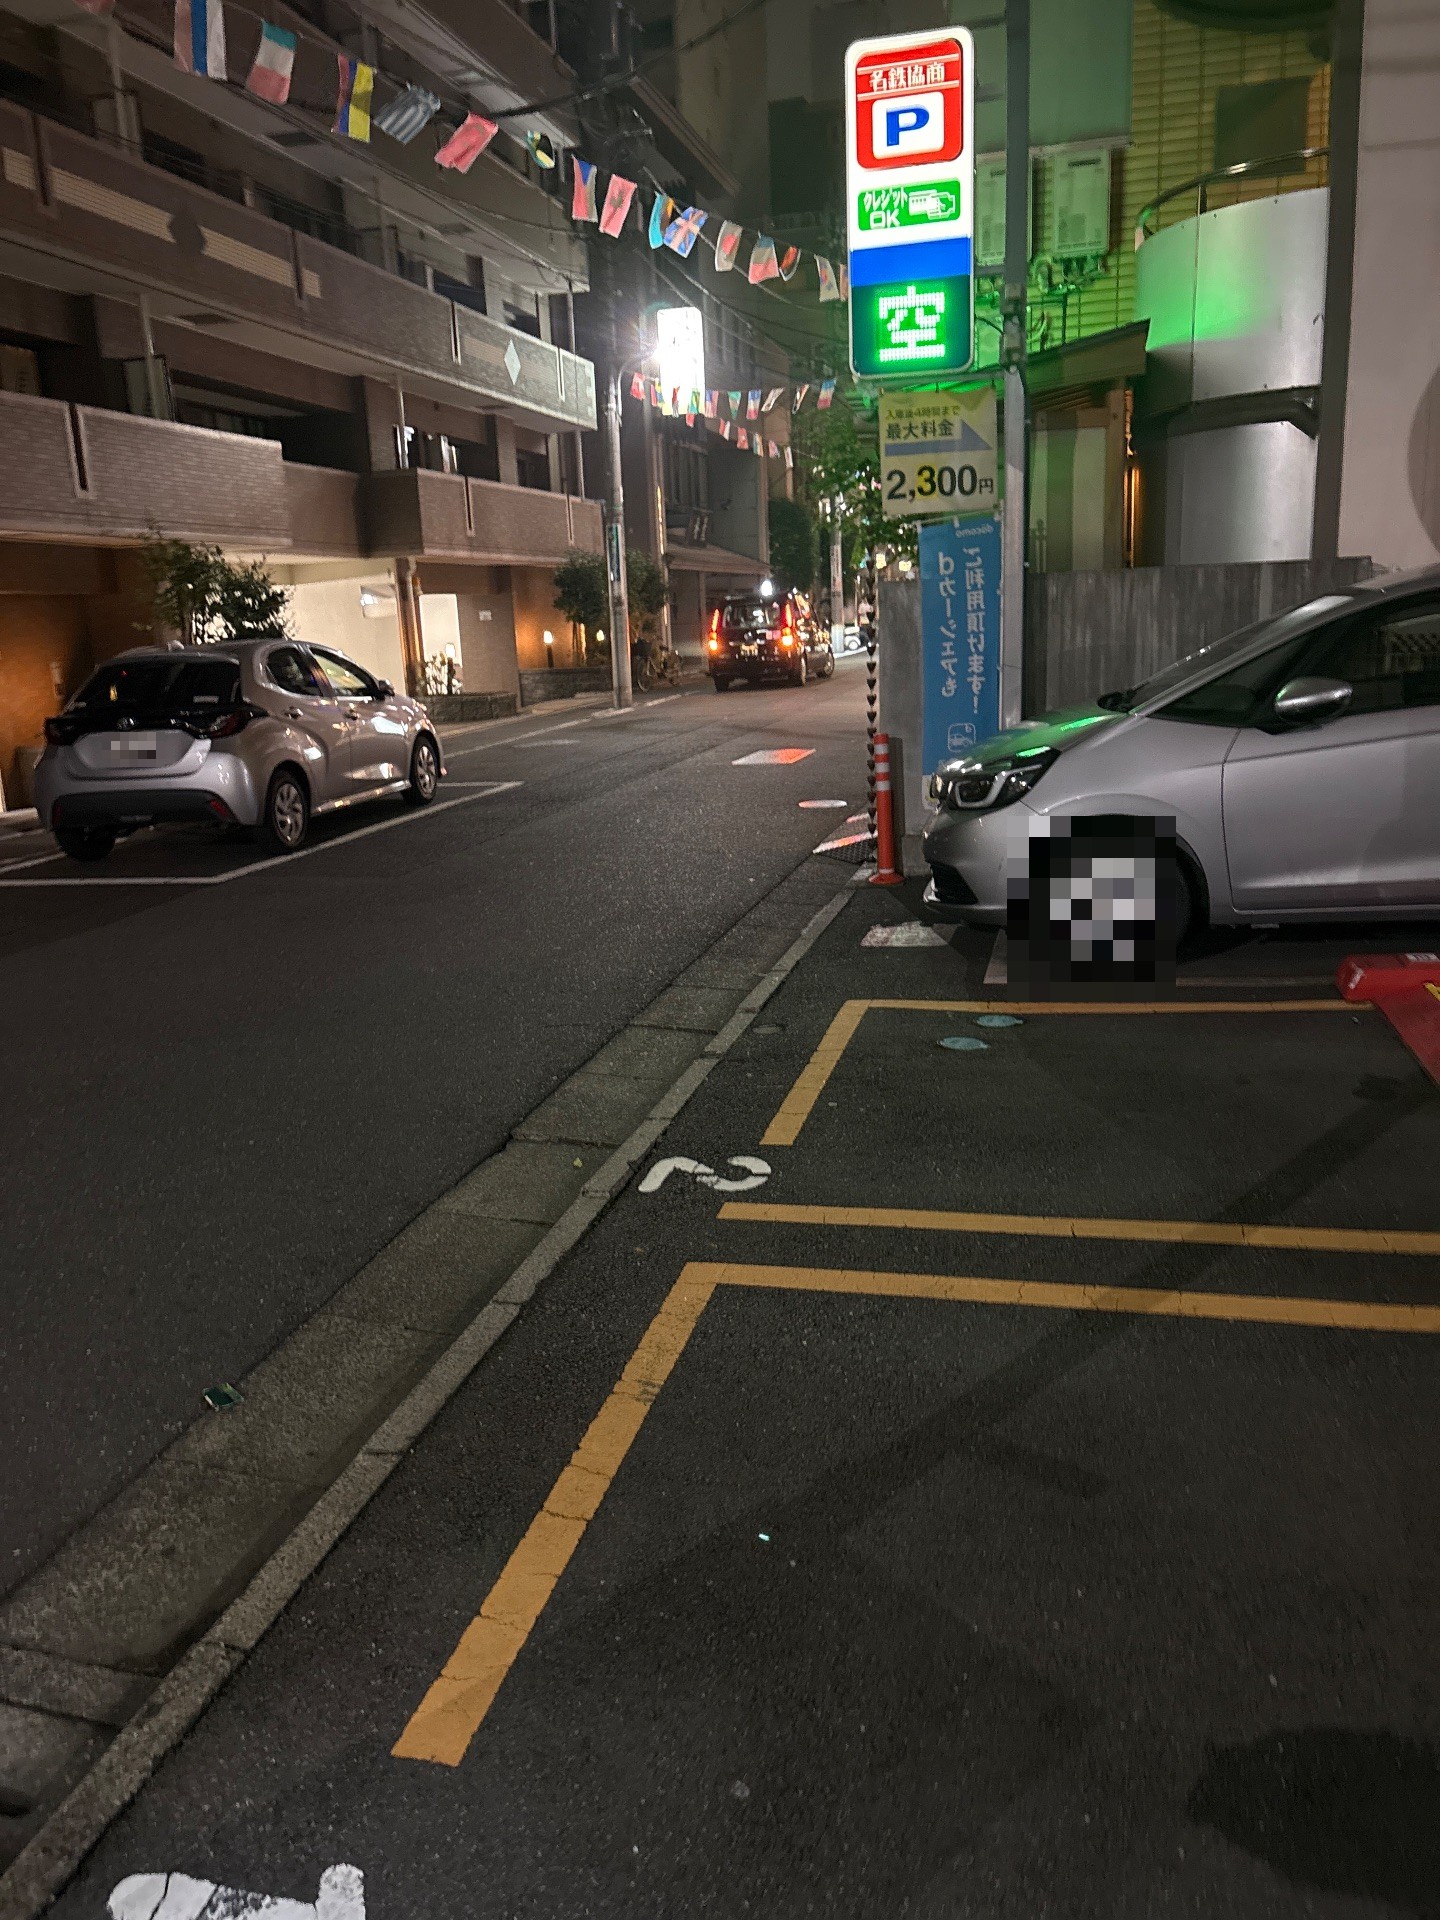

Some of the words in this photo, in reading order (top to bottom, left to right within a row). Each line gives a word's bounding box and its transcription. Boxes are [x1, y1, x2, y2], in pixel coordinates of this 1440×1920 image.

[869, 62, 945, 93] 名鉄協商
[886, 105, 930, 147] P
[863, 187, 908, 211] クレジット
[870, 208, 900, 230] OK
[879, 285, 945, 362] 空
[886, 418, 954, 440] 最大料金
[886, 464, 994, 501] 2,300円
[638, 1155, 772, 1192] 2
